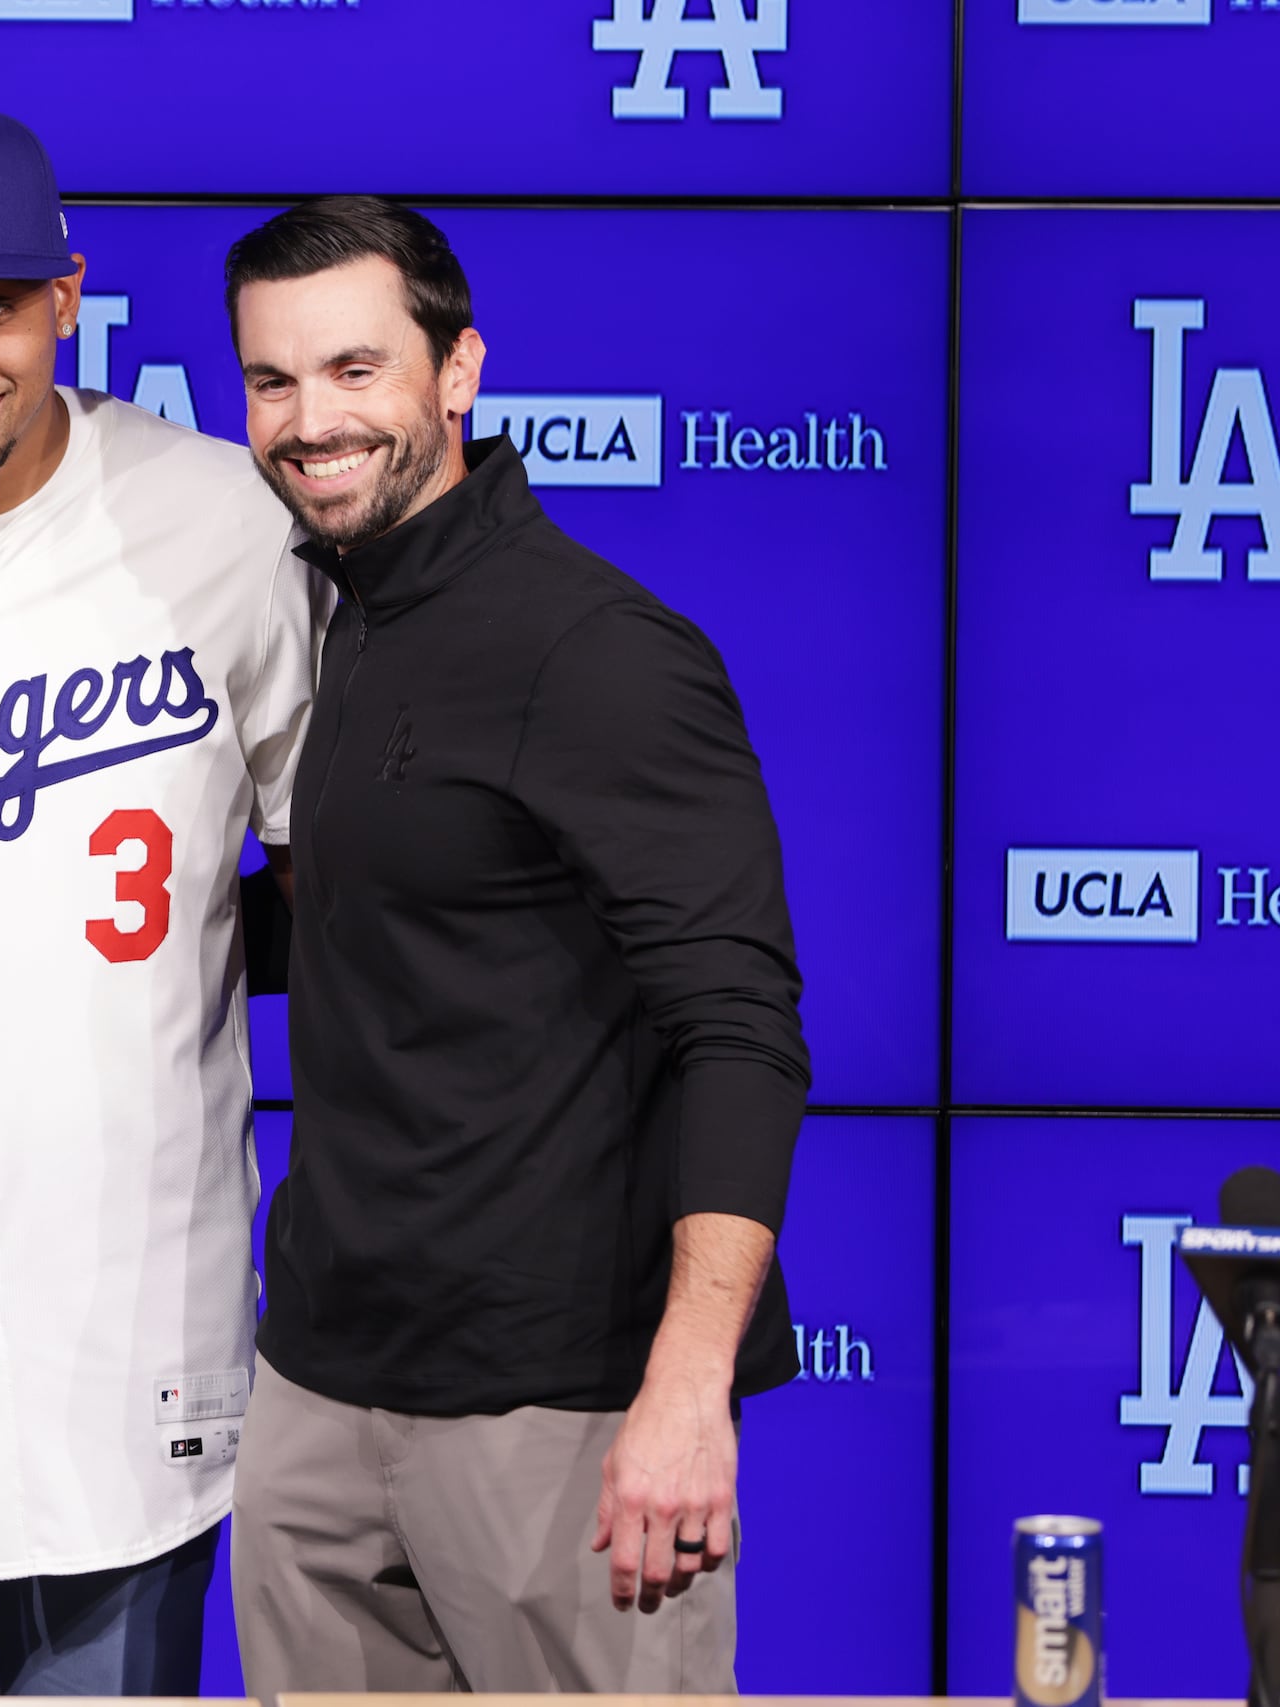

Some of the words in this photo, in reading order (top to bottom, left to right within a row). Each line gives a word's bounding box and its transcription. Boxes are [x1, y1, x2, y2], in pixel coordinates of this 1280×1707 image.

[679, 411, 888, 471] Health
[1130, 299, 1280, 580] LA
[85, 809, 173, 963] 3
[1034, 871, 1174, 918] UCLA
[1028, 1555, 1069, 1688] smart
